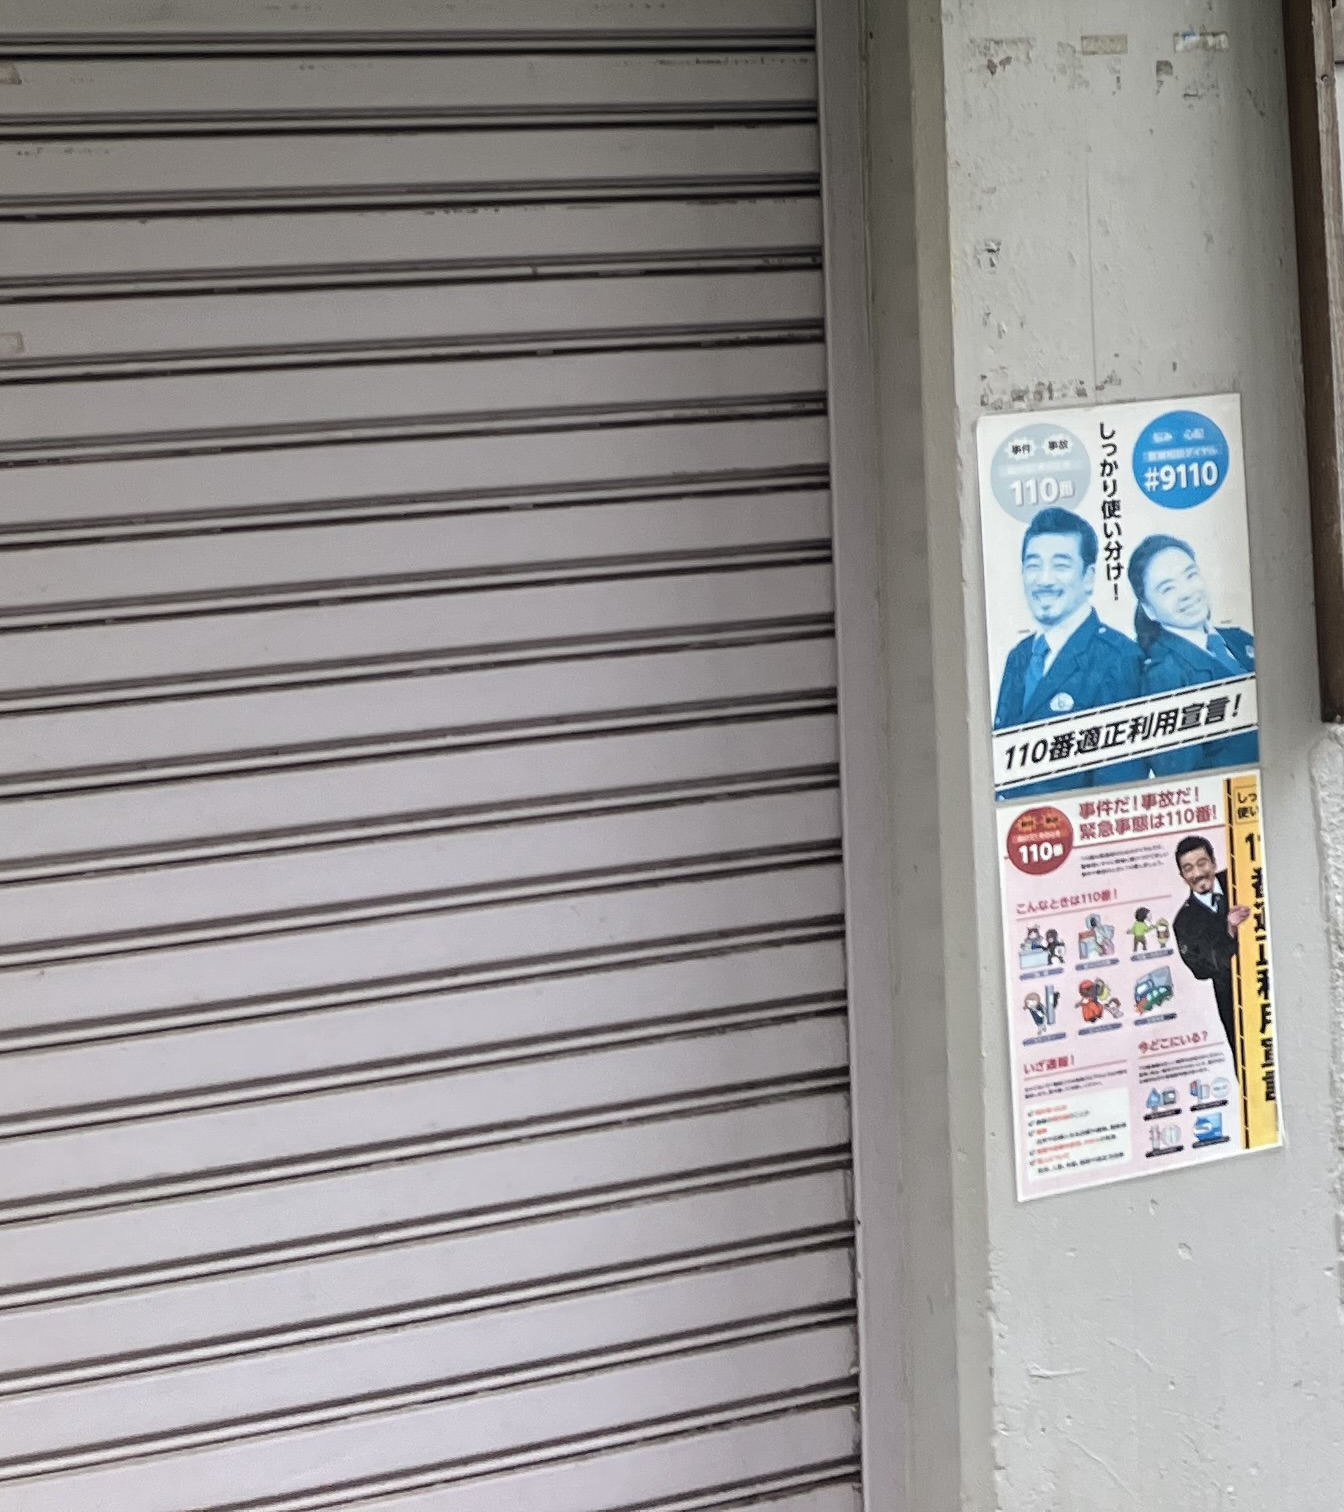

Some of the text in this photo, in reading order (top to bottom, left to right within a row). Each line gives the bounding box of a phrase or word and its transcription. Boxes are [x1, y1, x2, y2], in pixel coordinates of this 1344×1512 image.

[1011, 439, 1069, 456] 事件 事故
[1144, 460, 1218, 492] #9110
